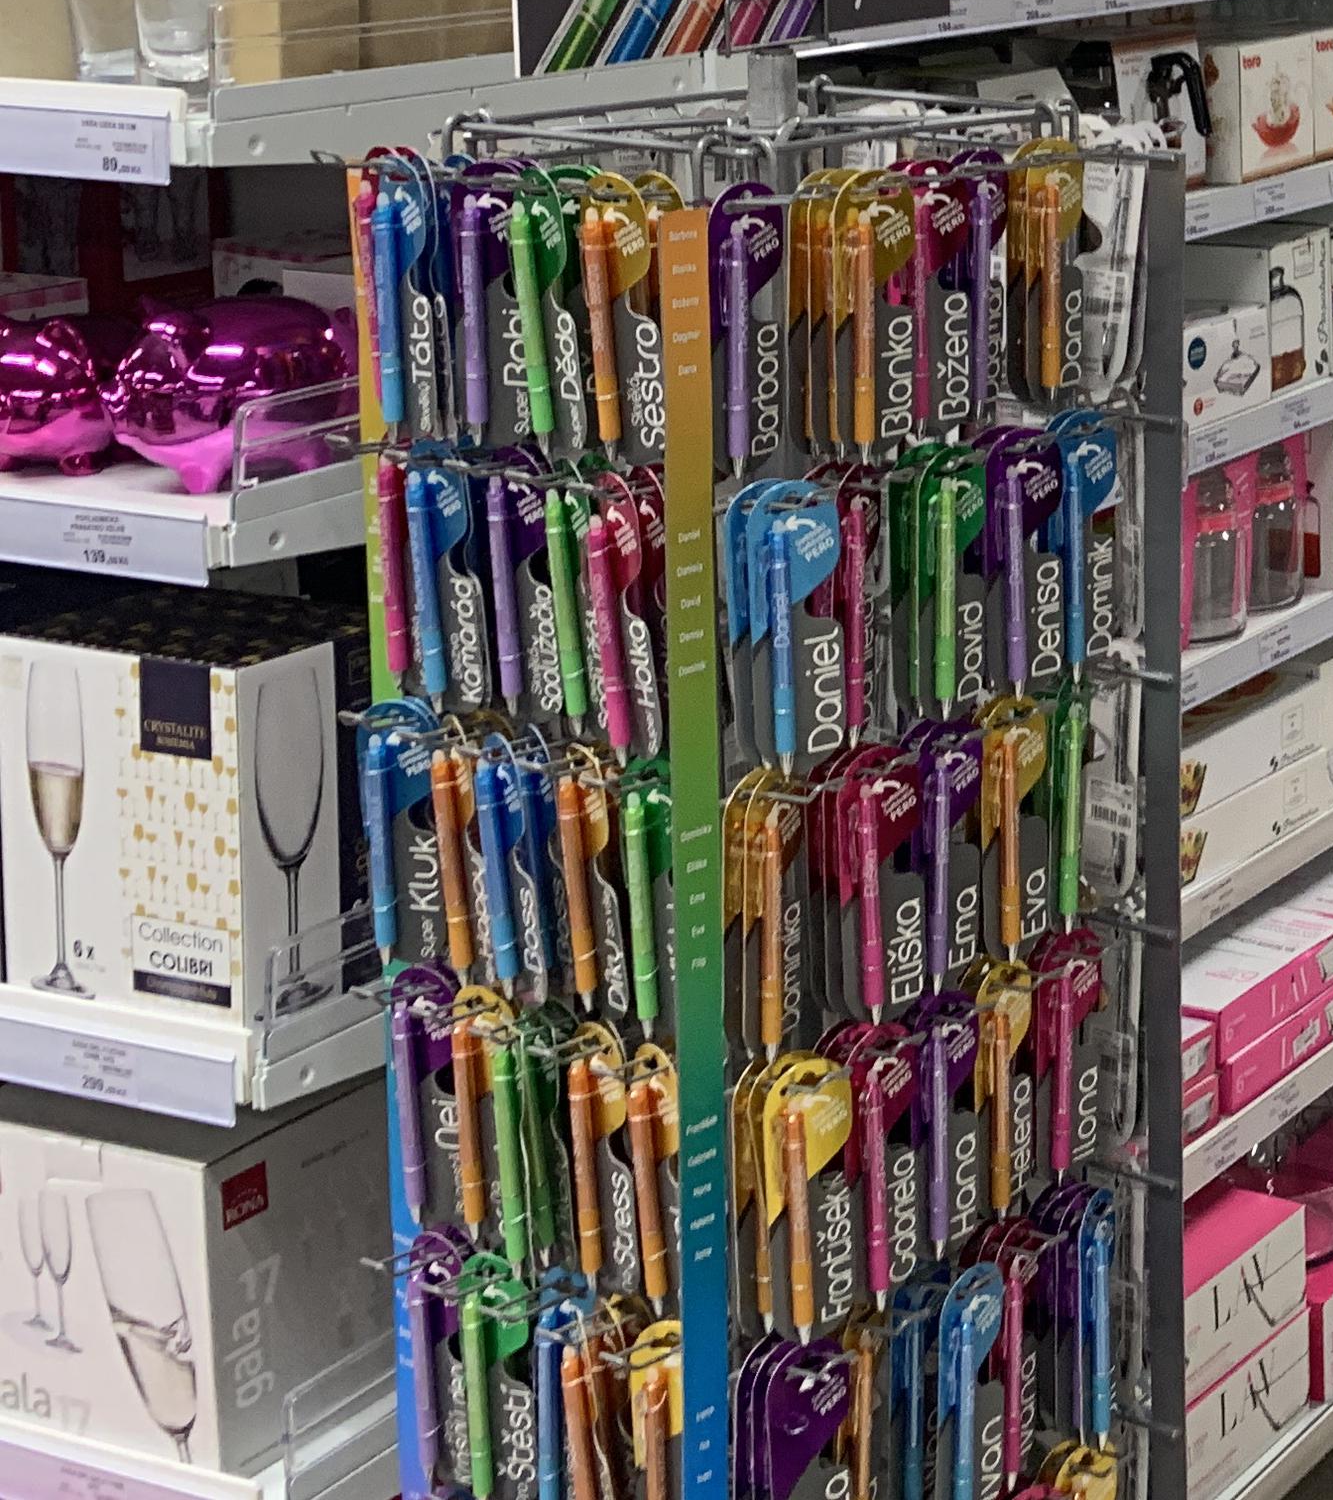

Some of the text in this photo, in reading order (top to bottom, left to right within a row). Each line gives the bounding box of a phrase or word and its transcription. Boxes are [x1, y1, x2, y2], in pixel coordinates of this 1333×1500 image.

[1242, 54, 1262, 71] toro
[636, 321, 667, 451] Sestra
[751, 323, 779, 457] Barbora
[881, 315, 913, 439] Blanka
[937, 292, 971, 421] Božena
[1060, 288, 1082, 388] Dana
[1031, 559, 1063, 678] Denisa
[1087, 537, 1115, 657] Dominik
[804, 626, 844, 754] Daniel
[958, 600, 985, 702] David
[408, 834, 440, 912] Kluk
[1021, 867, 1046, 940] Eva
[138, 921, 224, 954] Collection
[149, 950, 214, 977] COLIBRI
[887, 897, 924, 1005] Eliška
[949, 884, 977, 970] Ema
[951, 1130, 977, 1234] Hana
[1010, 1076, 1032, 1198] Helena
[817, 1171, 852, 1324] František
[888, 1150, 916, 1283] Gabriela
[1213, 1243, 1270, 1332] LAV
[1220, 1350, 1275, 1439] LAV
